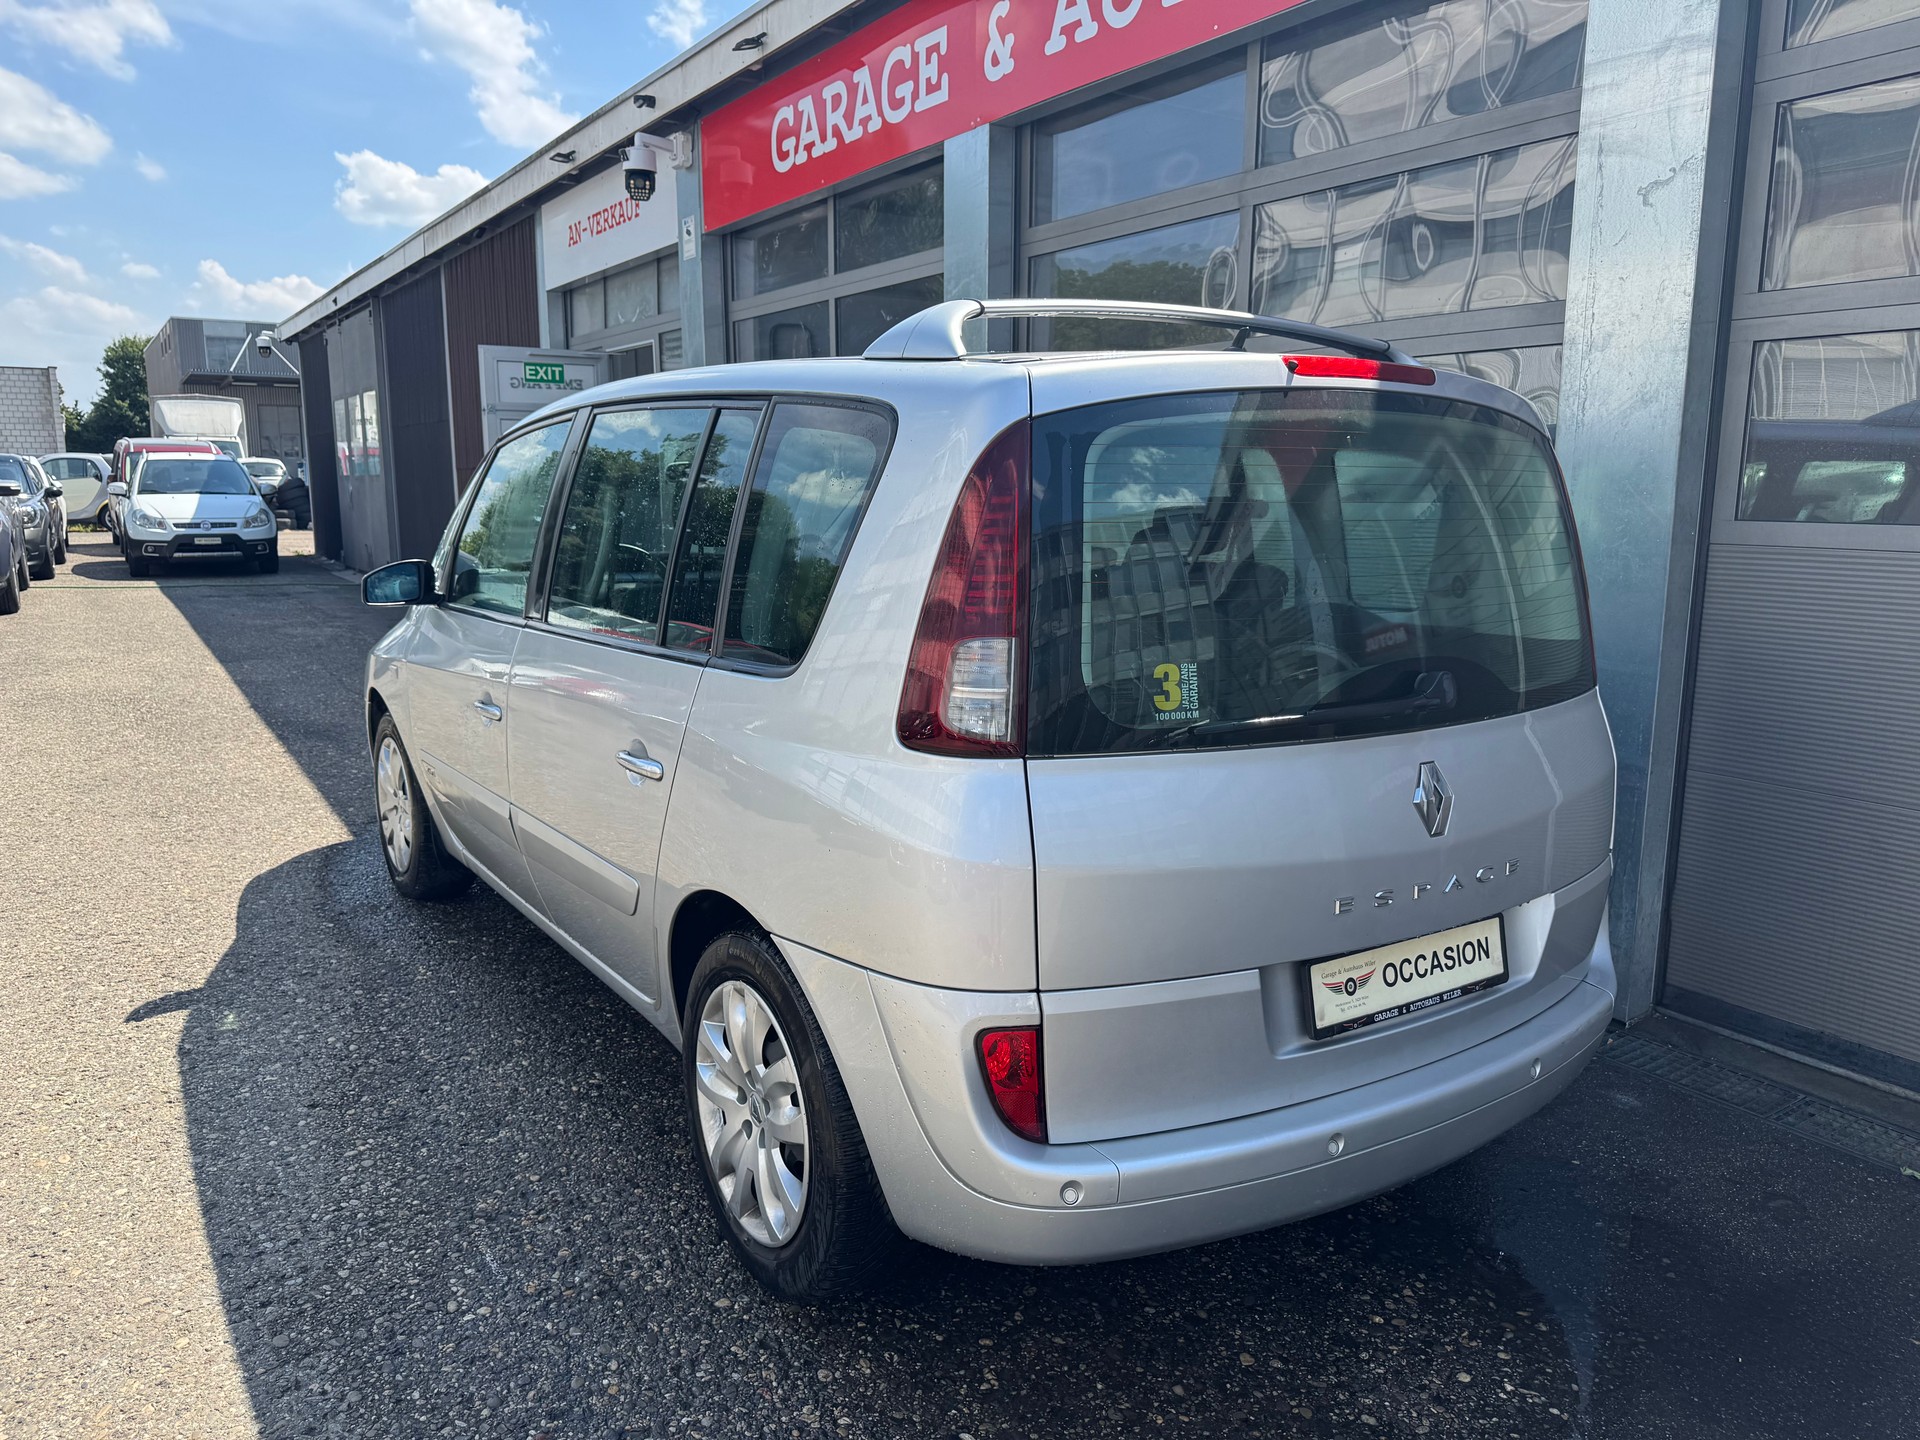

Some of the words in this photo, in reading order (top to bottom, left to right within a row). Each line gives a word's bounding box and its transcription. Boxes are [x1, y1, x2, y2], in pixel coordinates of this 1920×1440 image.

[771, 25, 948, 173] GARAGE
[983, 0, 1015, 81] &
[525, 365, 562, 381] EXIT
[1153, 663, 1181, 711] 3
[1180, 663, 1190, 710] JAHRE/ANS
[1189, 662, 1199, 710] GARANTIE
[1187, 710, 1199, 719] KM
[1333, 858, 1520, 915] ESPACE
[1321, 971, 1337, 980] Garage
[1382, 936, 1490, 988] OCCASION
[1373, 1008, 1399, 1022] GARAGE
[1402, 1006, 1407, 1014] &
[1409, 995, 1441, 1012] AUTOHAUS
[1442, 989, 1462, 1001] WILER
